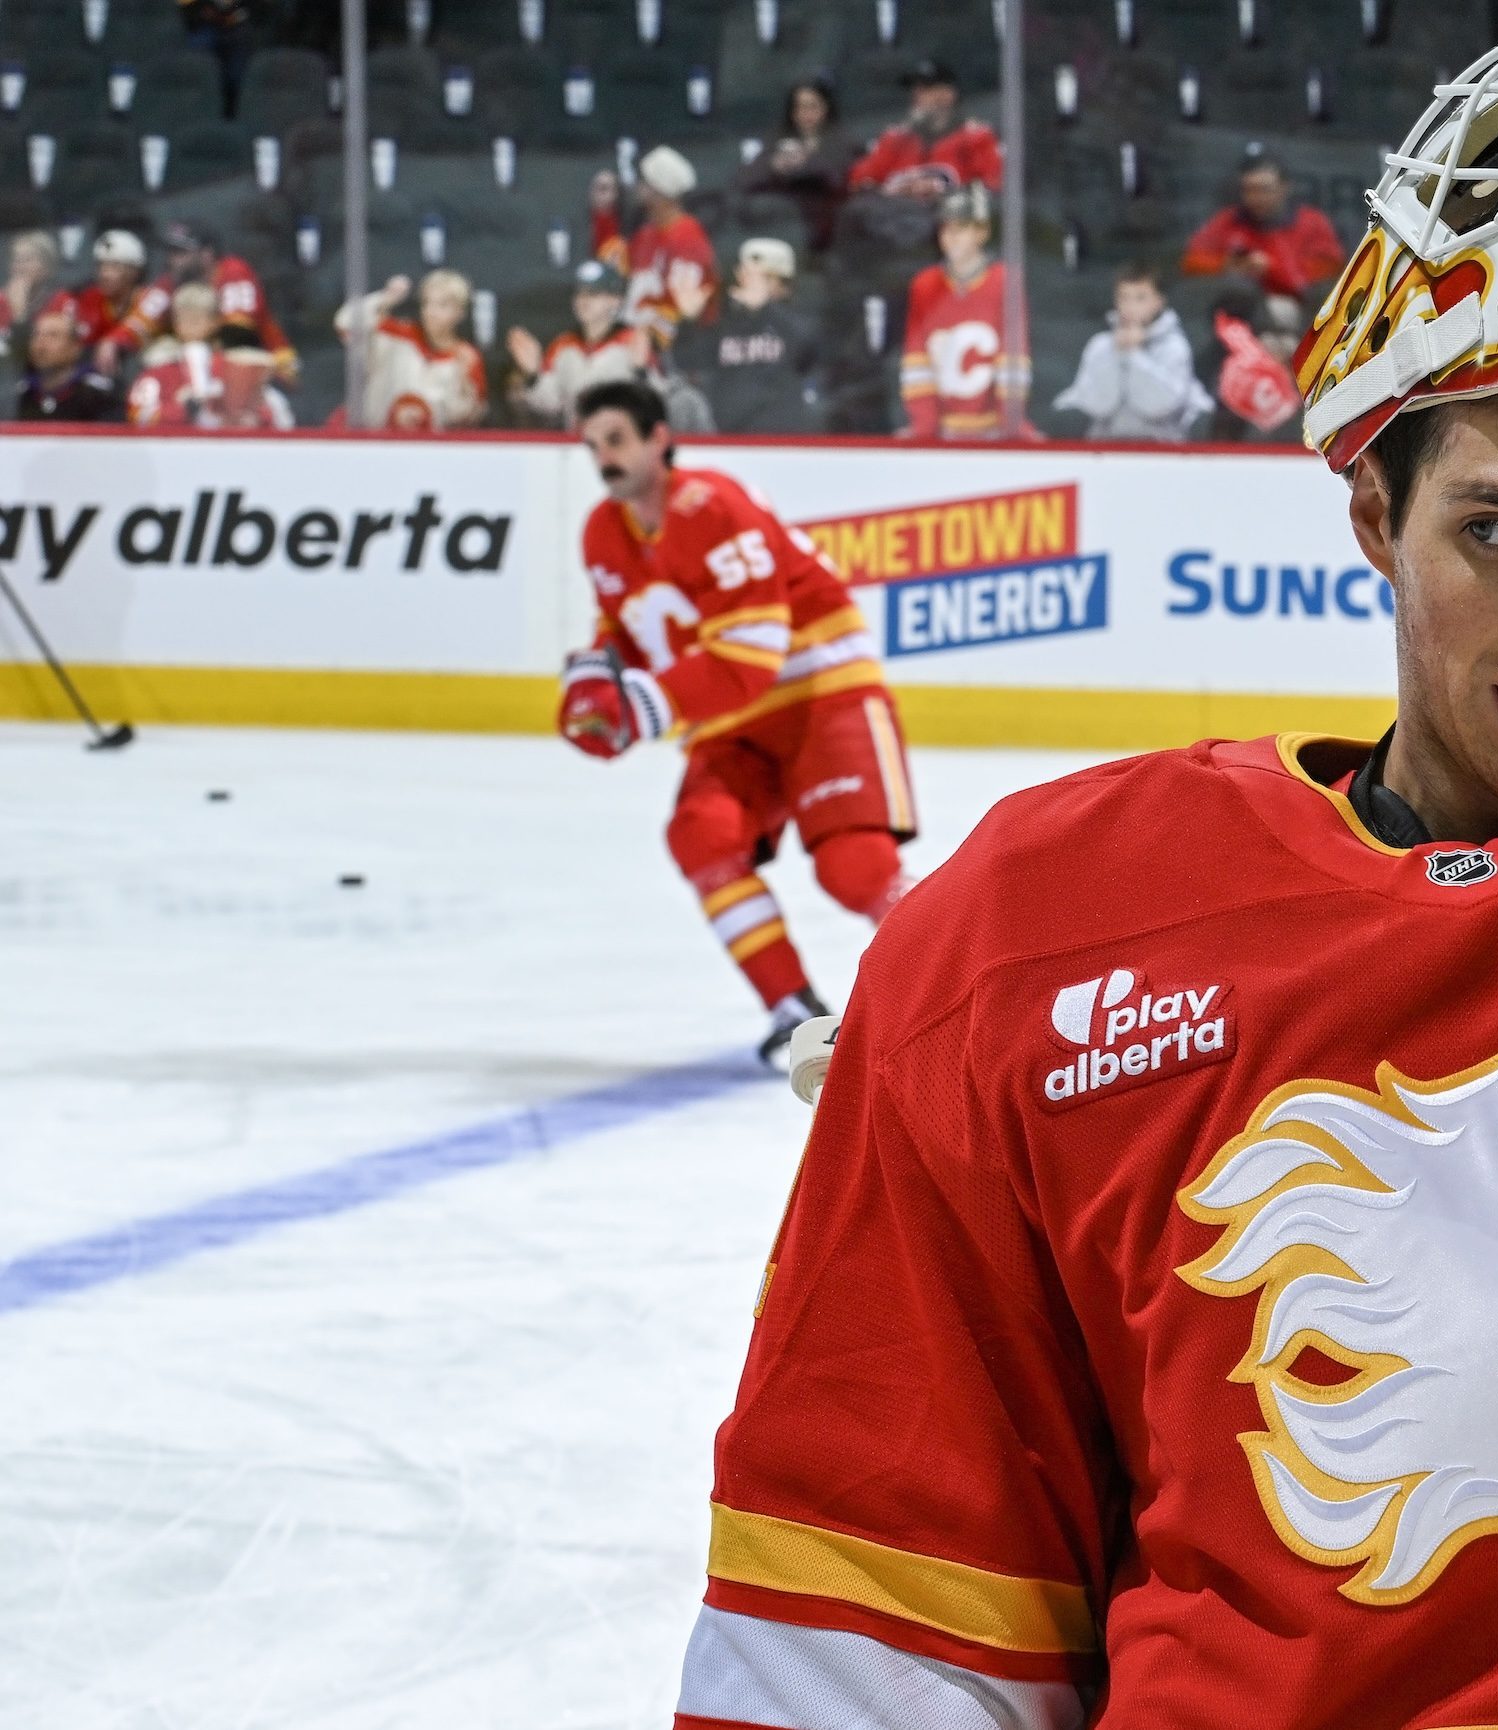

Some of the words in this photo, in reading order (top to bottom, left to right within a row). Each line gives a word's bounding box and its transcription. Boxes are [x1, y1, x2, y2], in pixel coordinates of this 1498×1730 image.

[117, 489, 513, 574] alberta
[705, 529, 776, 590] 55
[898, 561, 1098, 651] ENERGY
[1168, 552, 1395, 618] SUNC
[1443, 857, 1482, 881] NHL
[1105, 985, 1220, 1046] play
[1044, 1017, 1225, 1101] alberta
